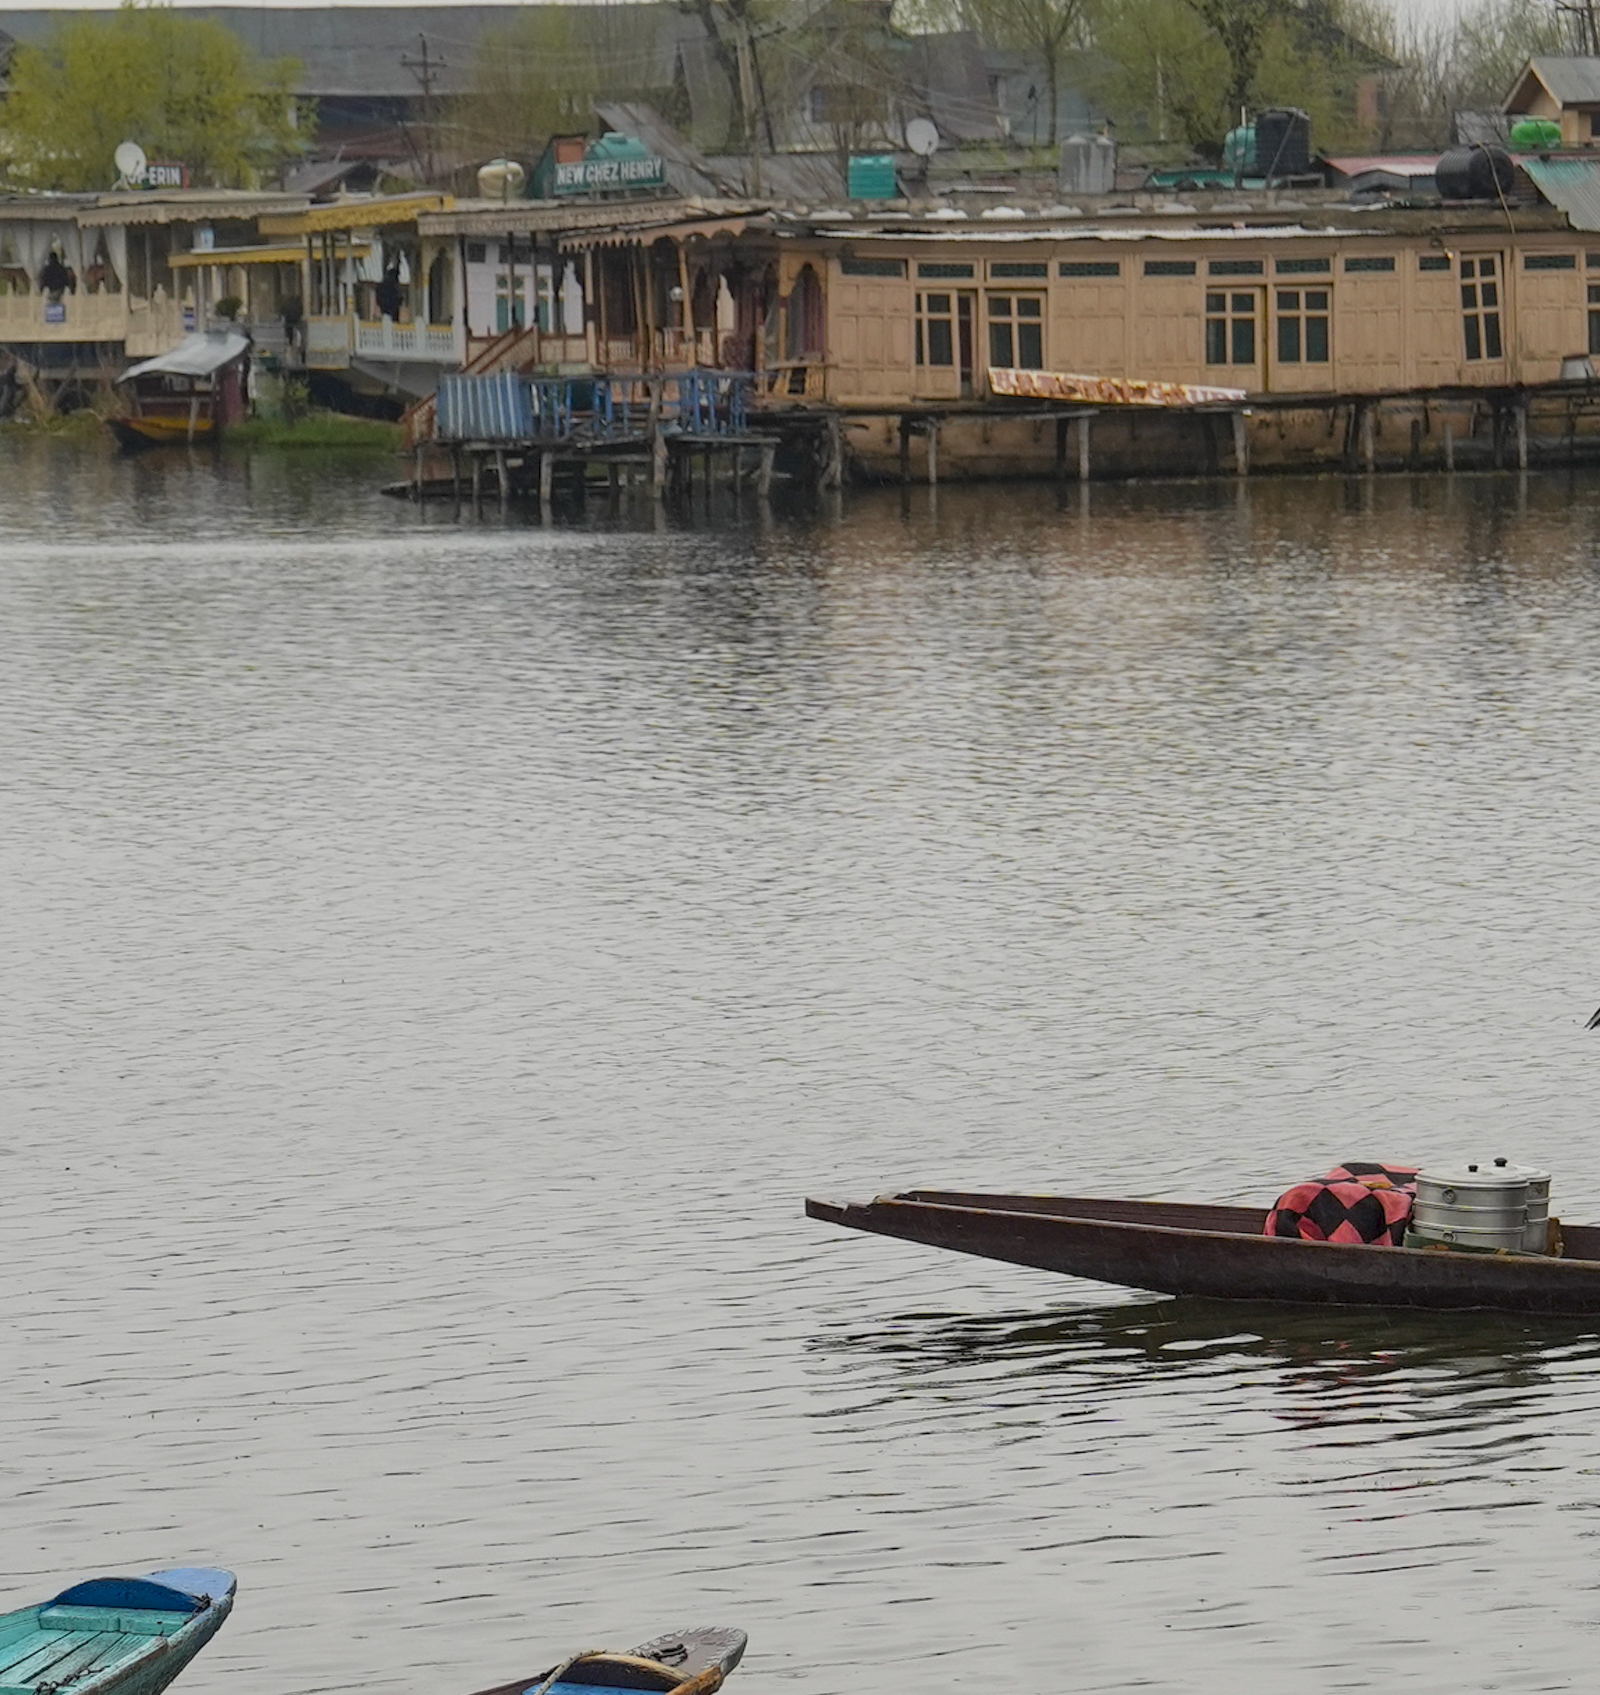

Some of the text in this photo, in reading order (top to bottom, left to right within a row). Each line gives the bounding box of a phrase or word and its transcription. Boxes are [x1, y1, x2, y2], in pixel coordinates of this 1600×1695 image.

[557, 157, 663, 185] NEW CHEZ HENRY
